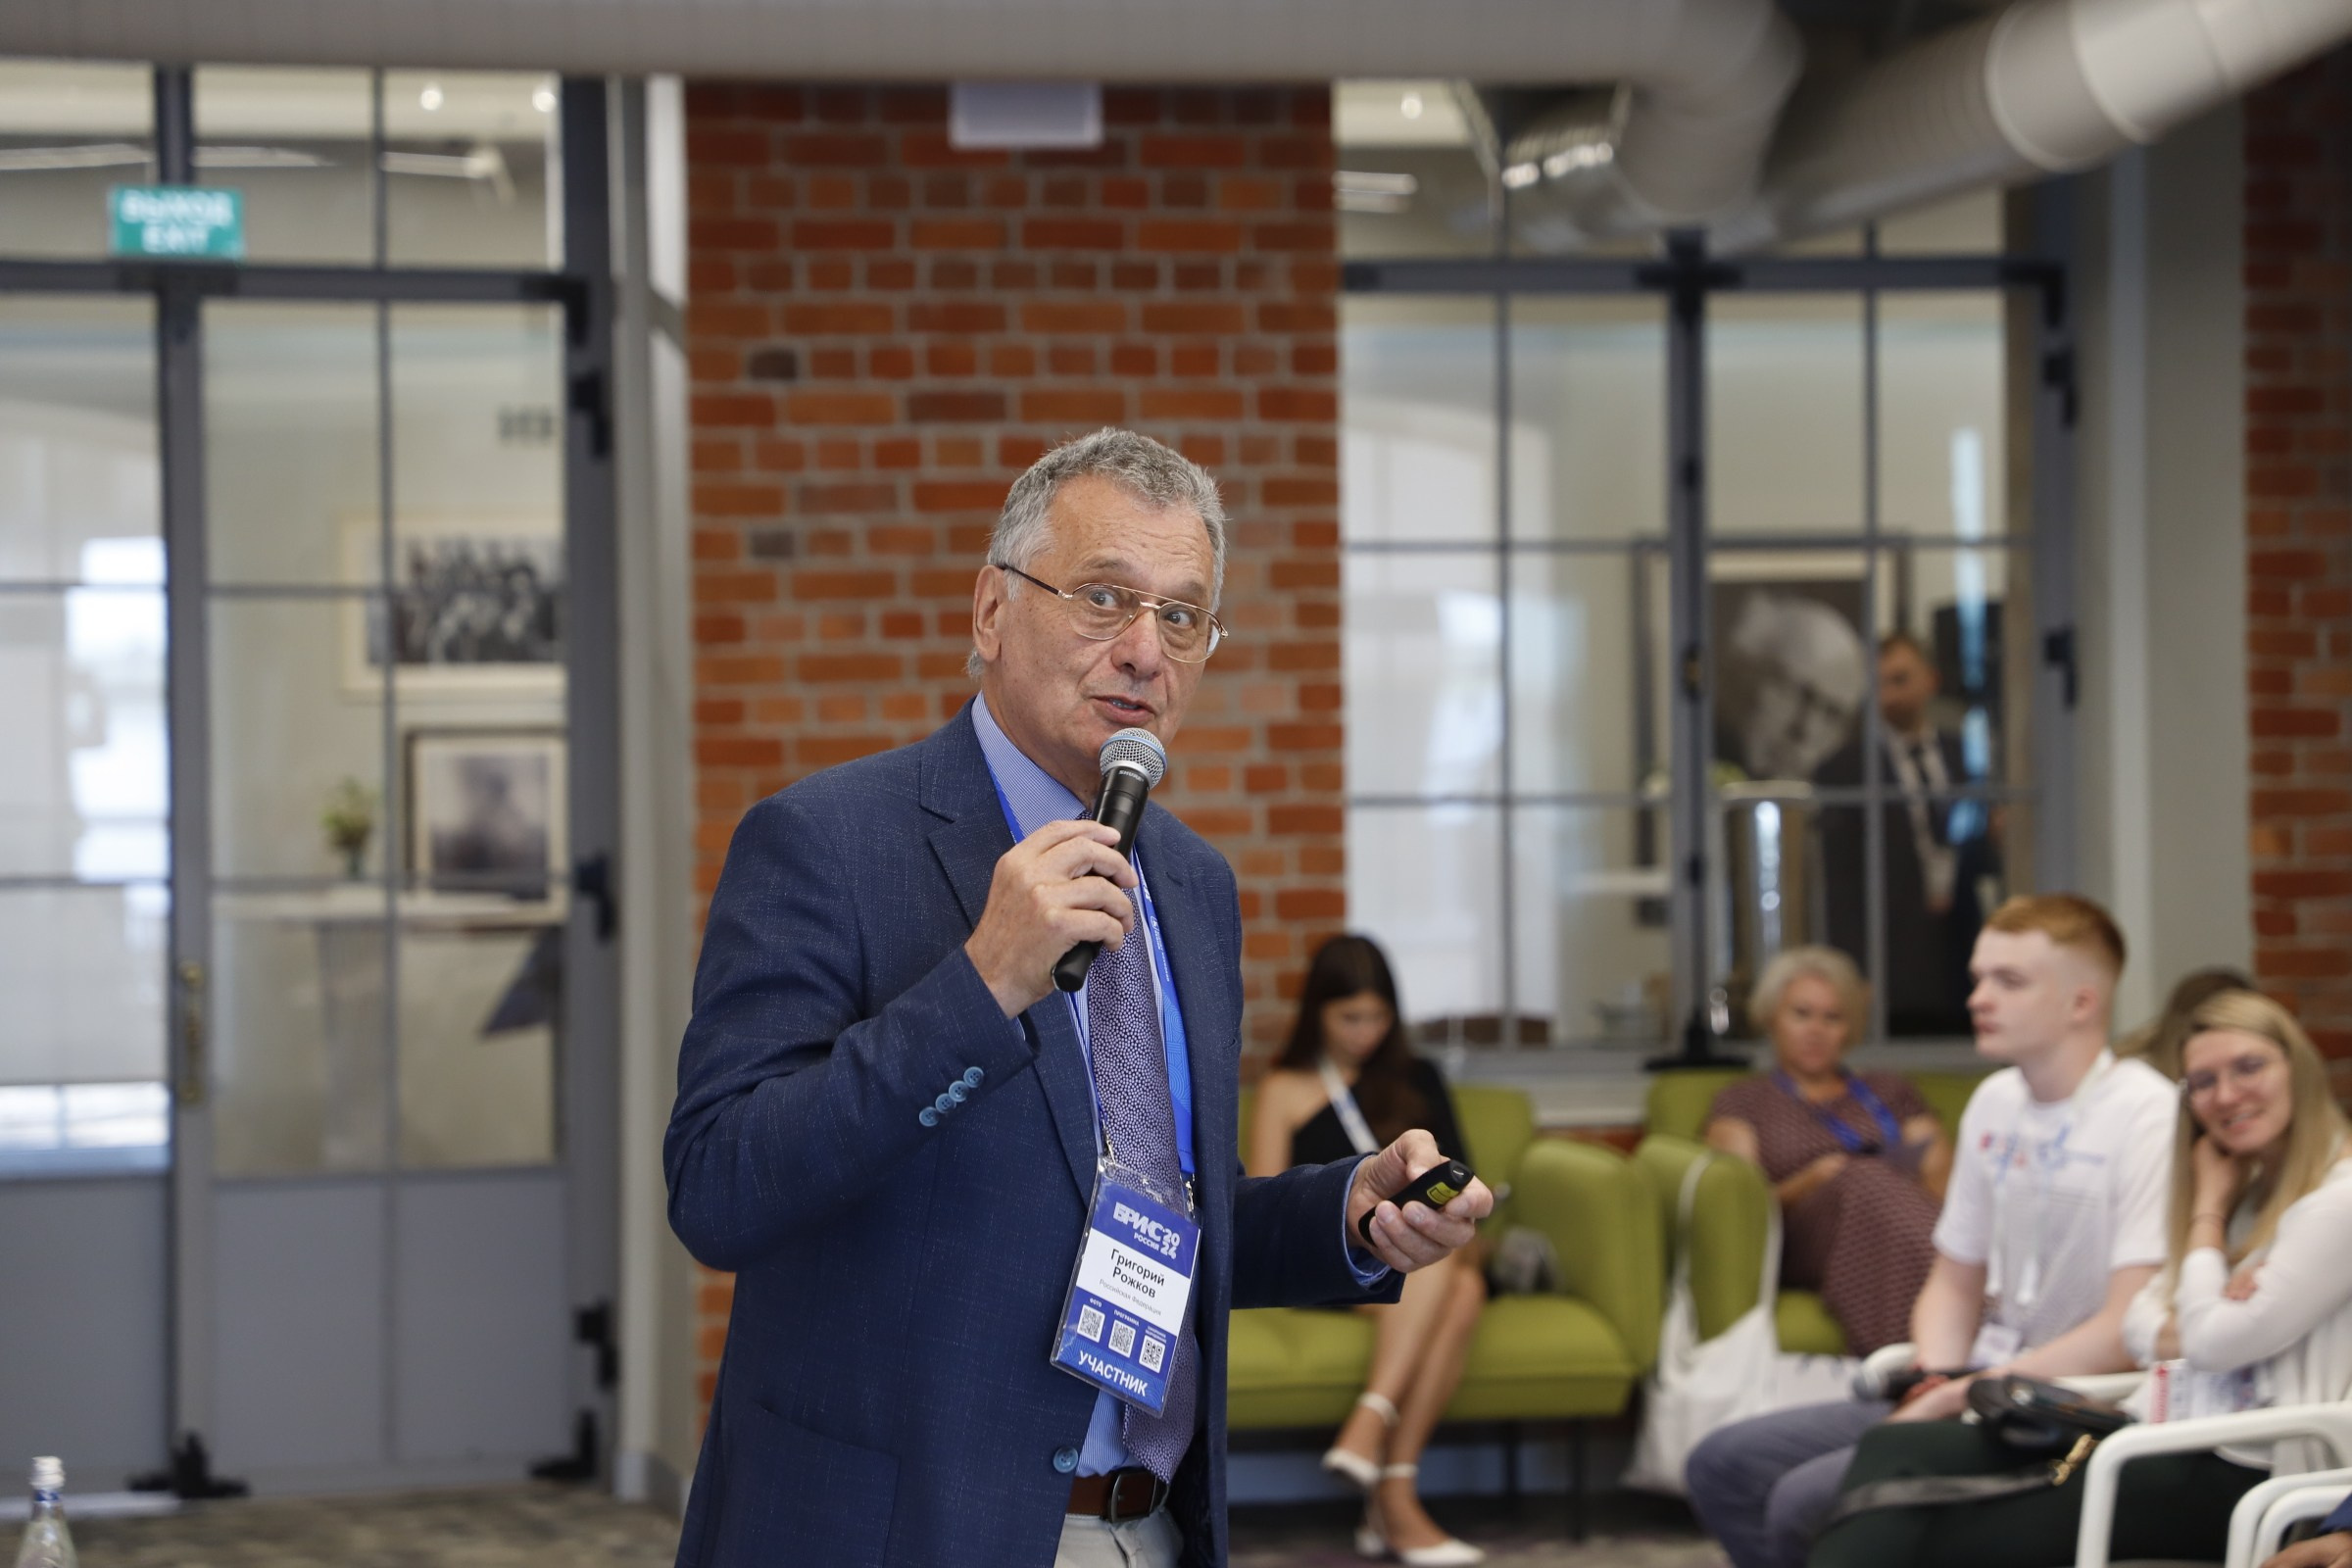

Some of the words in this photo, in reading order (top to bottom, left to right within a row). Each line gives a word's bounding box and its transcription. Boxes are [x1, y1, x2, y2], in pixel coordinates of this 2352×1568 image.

[1134, 1232, 1160, 1250] РОССИЯ
[1160, 1242, 1177, 1259] 24
[1110, 1248, 1165, 1286] Григорий
[1112, 1266, 1156, 1298] Рожков
[1089, 1298, 1102, 1308] ФОТО
[1099, 1278, 1131, 1300] Российская
[1132, 1294, 1162, 1316] Федерация
[1078, 1350, 1149, 1397] УЧАСТНИК
